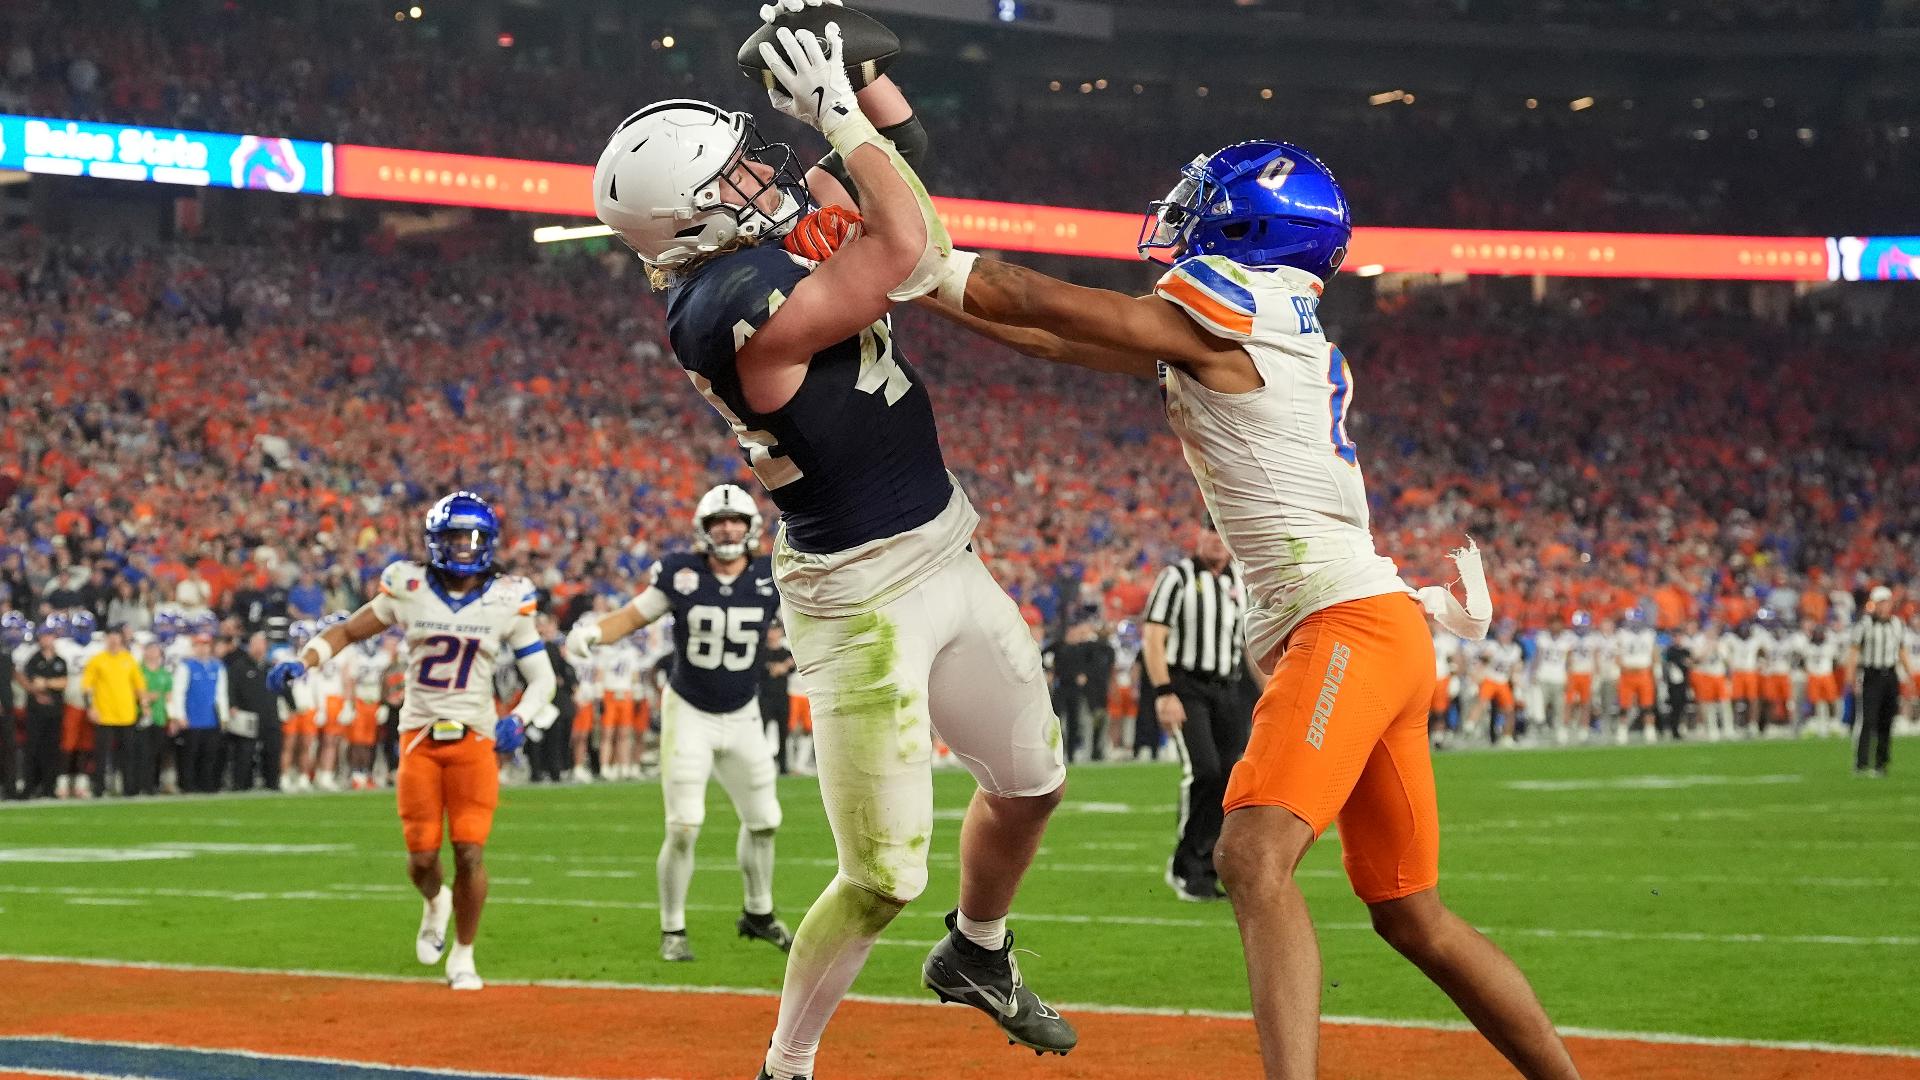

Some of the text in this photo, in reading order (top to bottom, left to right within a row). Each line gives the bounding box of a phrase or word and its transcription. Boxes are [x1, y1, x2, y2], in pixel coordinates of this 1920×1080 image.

[417, 634, 481, 690] 21
[686, 604, 765, 672] 85
[1304, 641, 1351, 752] BRONCOS
